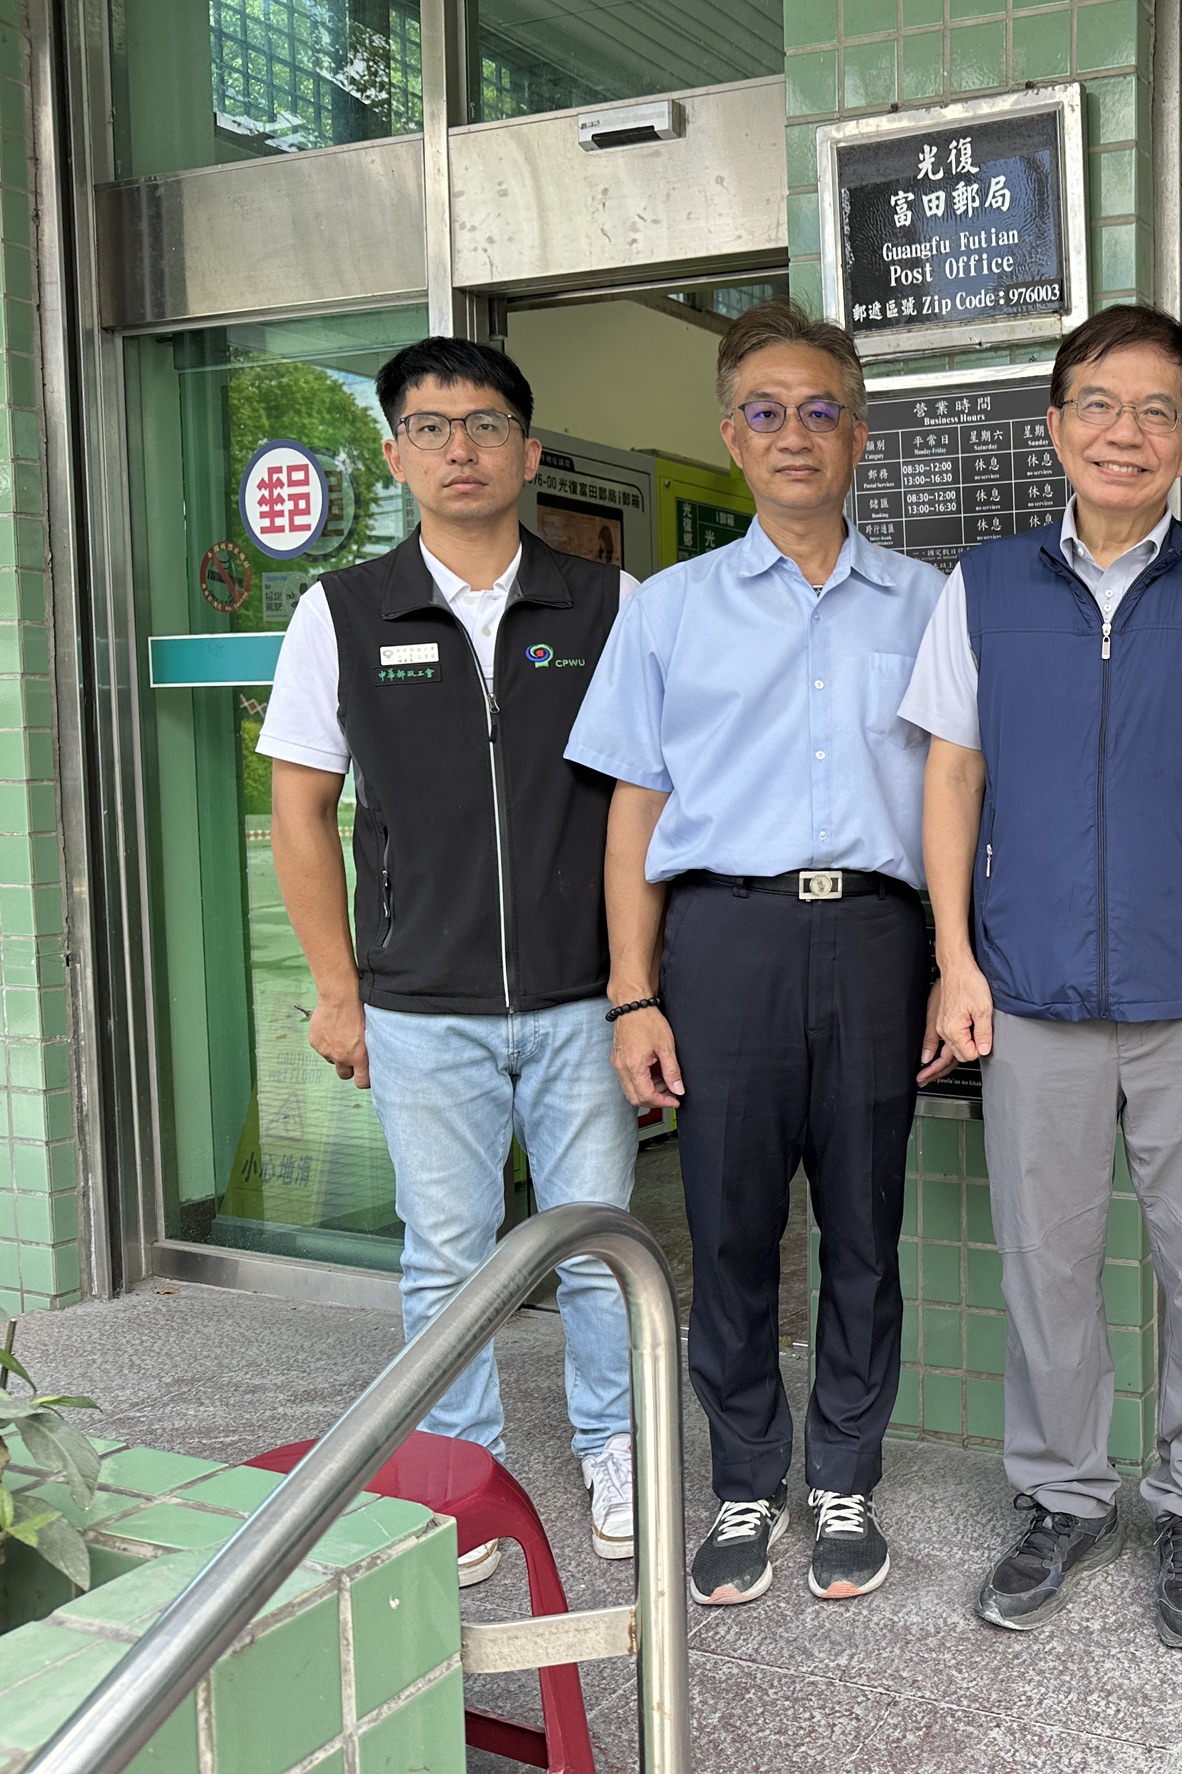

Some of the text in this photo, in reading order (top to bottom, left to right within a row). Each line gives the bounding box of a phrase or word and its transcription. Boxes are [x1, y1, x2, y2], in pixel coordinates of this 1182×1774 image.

[916, 137, 980, 181] 光復
[889, 174, 1011, 228] 富田郵局
[882, 227, 1019, 262] Guangfu Futian
[889, 253, 1014, 287] Post Office
[852, 296, 917, 323] 郵遞區號
[922, 295, 951, 315] Zip
[1008, 283, 1060, 306] 976003
[913, 396, 991, 418] 營業時間
[924, 413, 985, 426] Business Hours
[969, 429, 1003, 444] 星期六
[1023, 424, 1045, 439] 星期
[912, 434, 949, 448] 平常日
[974, 456, 1000, 471] 休息
[1027, 451, 1053, 467] 休息
[867, 468, 889, 480] 郵務
[902, 461, 952, 475] 08:30~12:00
[903, 473, 953, 486] 13:00~16:30
[906, 490, 956, 504] 08:30~12:00
[975, 487, 1001, 502] 休息
[1028, 483, 1054, 498] 休息
[256, 463, 312, 535] 郵
[907, 502, 957, 515] 13:00~16:30
[976, 516, 1002, 532] 休息
[555, 658, 586, 668] CPWU
[241, 1151, 313, 1188] 小心地滑
